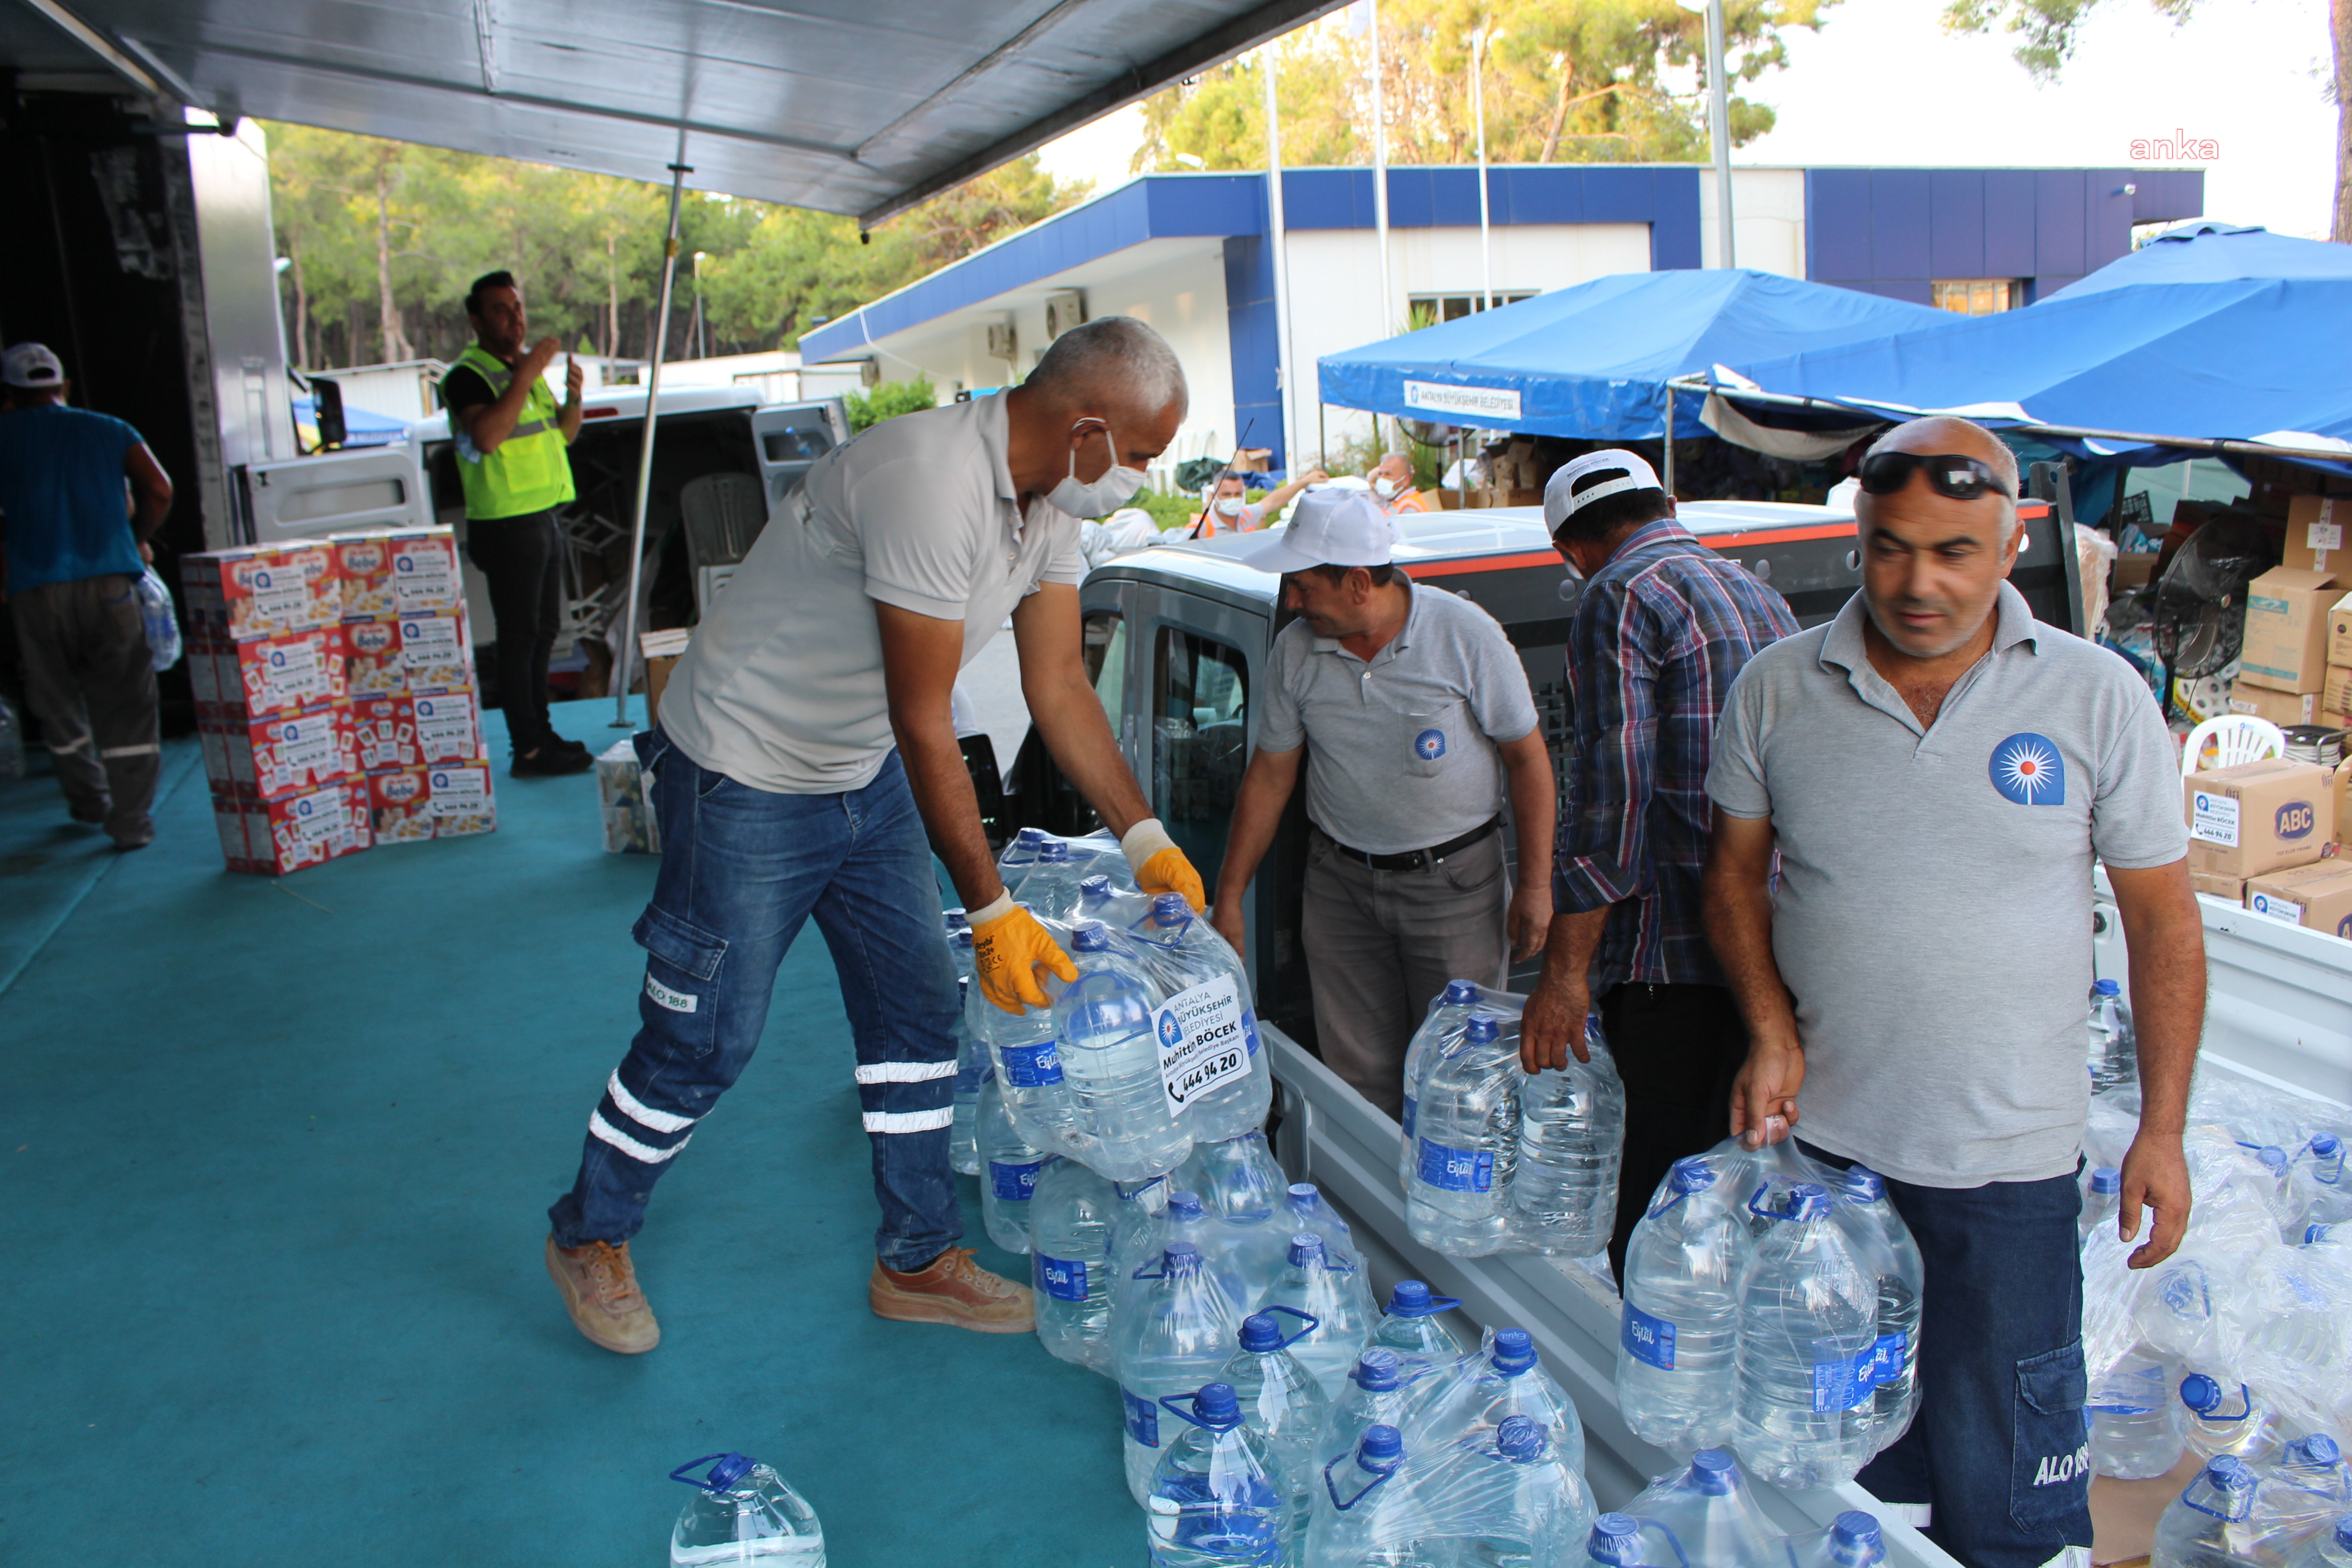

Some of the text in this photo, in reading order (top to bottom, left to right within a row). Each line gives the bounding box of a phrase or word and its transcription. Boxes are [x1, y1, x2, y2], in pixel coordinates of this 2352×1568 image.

[1421, 390, 1442, 402] ANTALYA
[304, 564, 323, 575] ebe
[2204, 828, 2215, 836] 444
[2279, 807, 2311, 835] ABC
[667, 995, 688, 1008] 188
[1174, 991, 1211, 1013] ANTALYA
[1177, 994, 1233, 1025] BÜYÜKŞEHİR
[1163, 1040, 1197, 1070] Muhittin
[1196, 1020, 1237, 1046] BÖCEK
[1183, 1054, 1237, 1091] 444 94 20
[1446, 1160, 1474, 1177] Eylül
[1045, 1268, 1069, 1284] Eylül
[1631, 1320, 1655, 1345] Eylül
[2033, 1454, 2073, 1485] ALO
